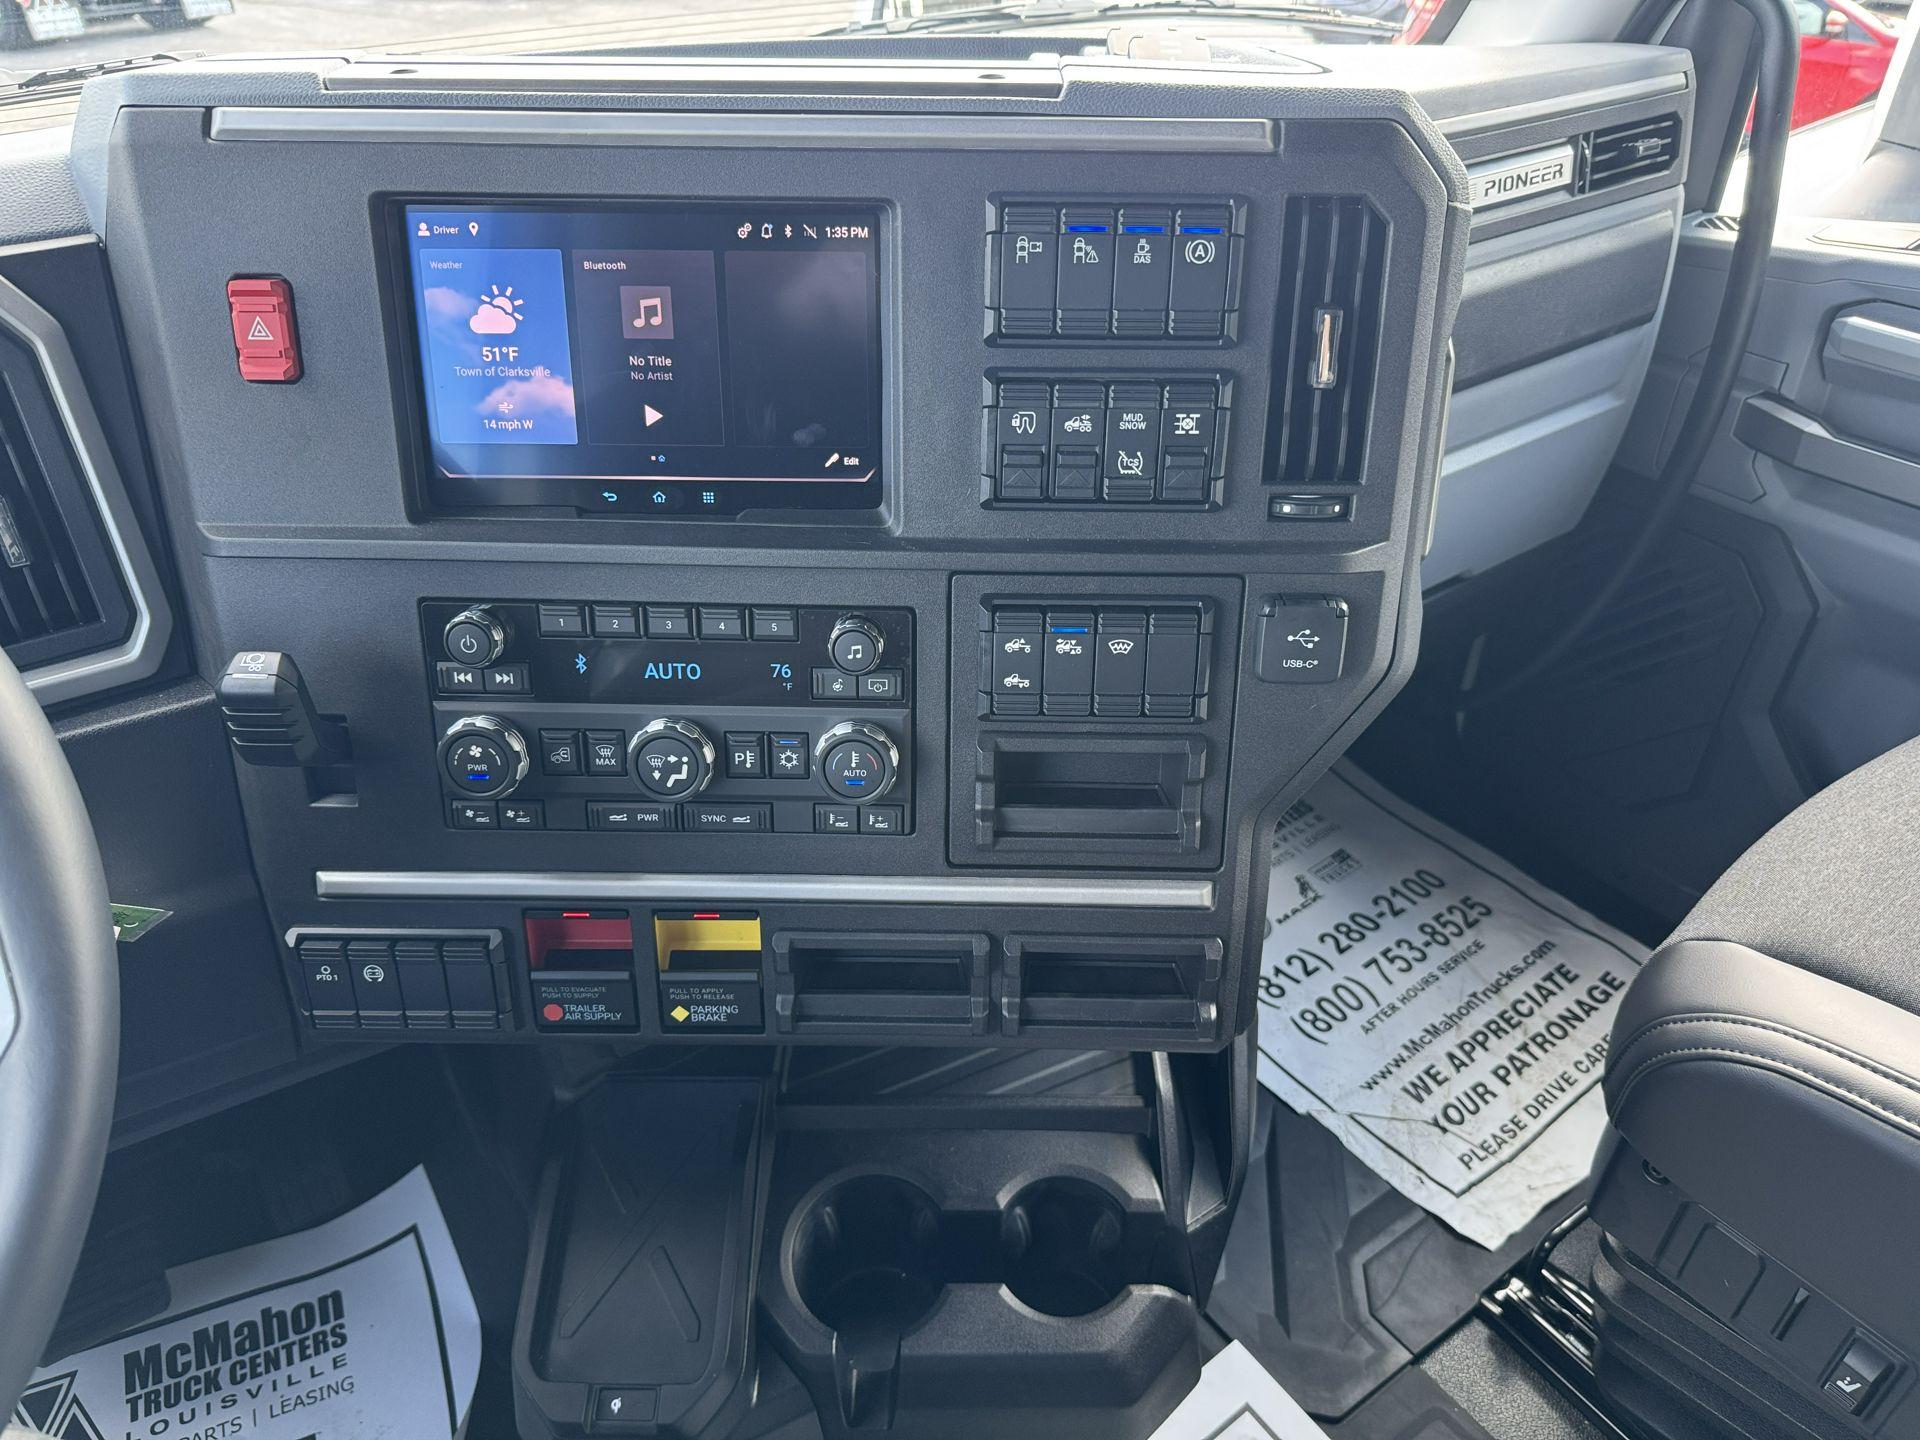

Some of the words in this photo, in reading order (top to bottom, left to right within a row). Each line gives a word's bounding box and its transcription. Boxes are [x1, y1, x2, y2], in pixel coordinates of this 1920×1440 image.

[1484, 163, 1564, 197] PIONEER
[433, 225, 459, 235] Driver
[825, 227, 848, 238] 1:35
[850, 227, 869, 238] PM
[1133, 255, 1151, 264] DAS
[429, 260, 463, 270] Weather
[583, 261, 627, 270] Bluetooth
[481, 347, 519, 362] 51°F
[629, 356, 645, 366] No
[647, 356, 672, 366] Title
[454, 366, 482, 376] Town
[484, 366, 496, 376] of
[497, 366, 551, 377] Clarksville
[630, 371, 645, 380] No
[647, 371, 673, 380] Artist
[1122, 413, 1143, 422] MUD
[483, 420, 496, 429] 14
[498, 420, 521, 431] mph
[523, 420, 533, 429] W
[1119, 421, 1147, 430] SNOW
[844, 457, 860, 466] Edit
[1121, 457, 1140, 467] TCS
[558, 618, 564, 627] 1
[612, 620, 619, 628] 2
[665, 621, 672, 629] 3
[718, 622, 725, 631] 4
[771, 623, 778, 632] 5
[644, 663, 701, 680] AUTO
[770, 664, 792, 678] 76
[595, 758, 616, 766] MAX
[843, 769, 867, 777] AUTO
[701, 814, 727, 823] SYNC
[1317, 868, 1446, 955] 280-2100
[1290, 975, 1381, 1046] (800)
[1361, 896, 1493, 986] 753-8525
[1360, 1002, 1401, 1035] AFTER
[1401, 972, 1440, 1006] HOURS
[1437, 938, 1486, 976] SERVICE
[563, 1004, 606, 1012] TRAILER
[690, 1005, 739, 1014] PARKING
[564, 1012, 582, 1021] AIR
[583, 1012, 622, 1021] SUPPLY
[691, 1013, 728, 1022] BRAKE
[1360, 938, 1558, 1092] www.McMahonTrucks.com
[1401, 1063, 1450, 1105] WE
[1445, 962, 1581, 1074] APPRECIATE
[1431, 1081, 1499, 1135] YOUR
[1490, 970, 1627, 1086] PATRONAGE
[1457, 1116, 1528, 1171] PLEASE
[1523, 1070, 1579, 1120] DRIVE
[123, 1288, 345, 1395] McMahon
[125, 1365, 223, 1423] TRUCK
[229, 1322, 348, 1386] CENTERS
[126, 1353, 348, 1440] LOUISVILLE
[180, 1416, 242, 1440] ARTS
[269, 1375, 355, 1420] LEASING
